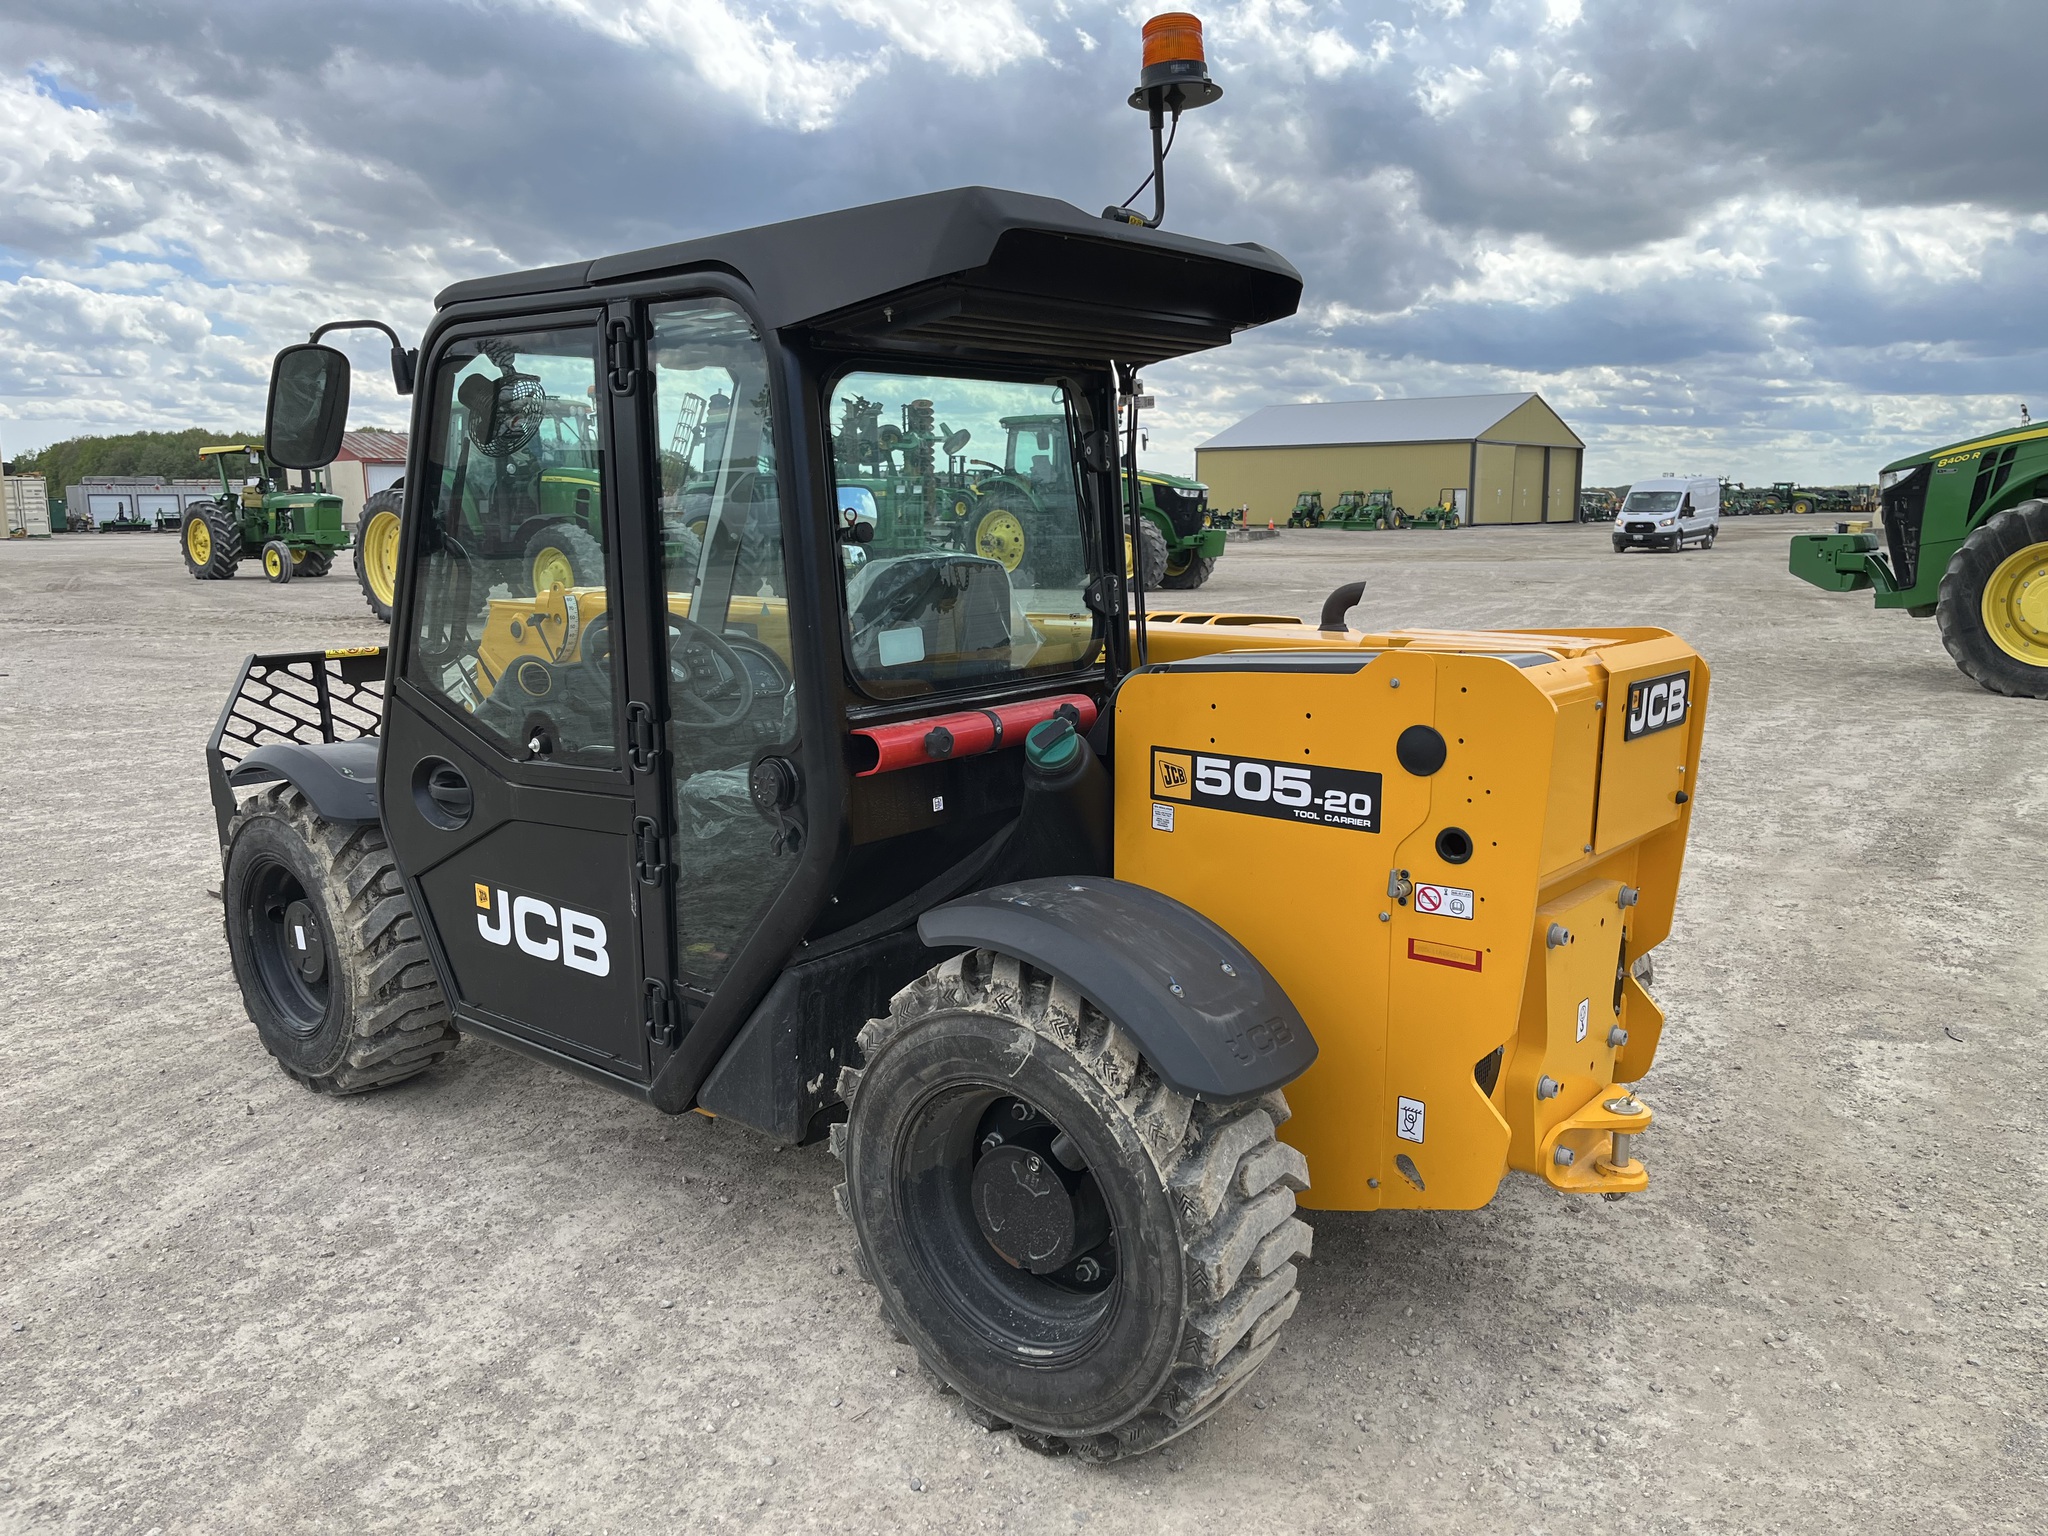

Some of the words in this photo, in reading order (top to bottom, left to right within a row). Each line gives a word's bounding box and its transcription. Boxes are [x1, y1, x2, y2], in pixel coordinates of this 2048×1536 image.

[1937, 454, 1970, 467] 8400
[1971, 451, 1981, 460] R
[1630, 679, 1686, 734] JCB
[1163, 763, 1185, 785] JCB
[1195, 756, 1371, 816] 505-20
[1293, 809, 1320, 820] TOOL
[1324, 814, 1371, 828] CARRIER
[476, 888, 610, 977] JCB
[1225, 1016, 1294, 1066] JCB
